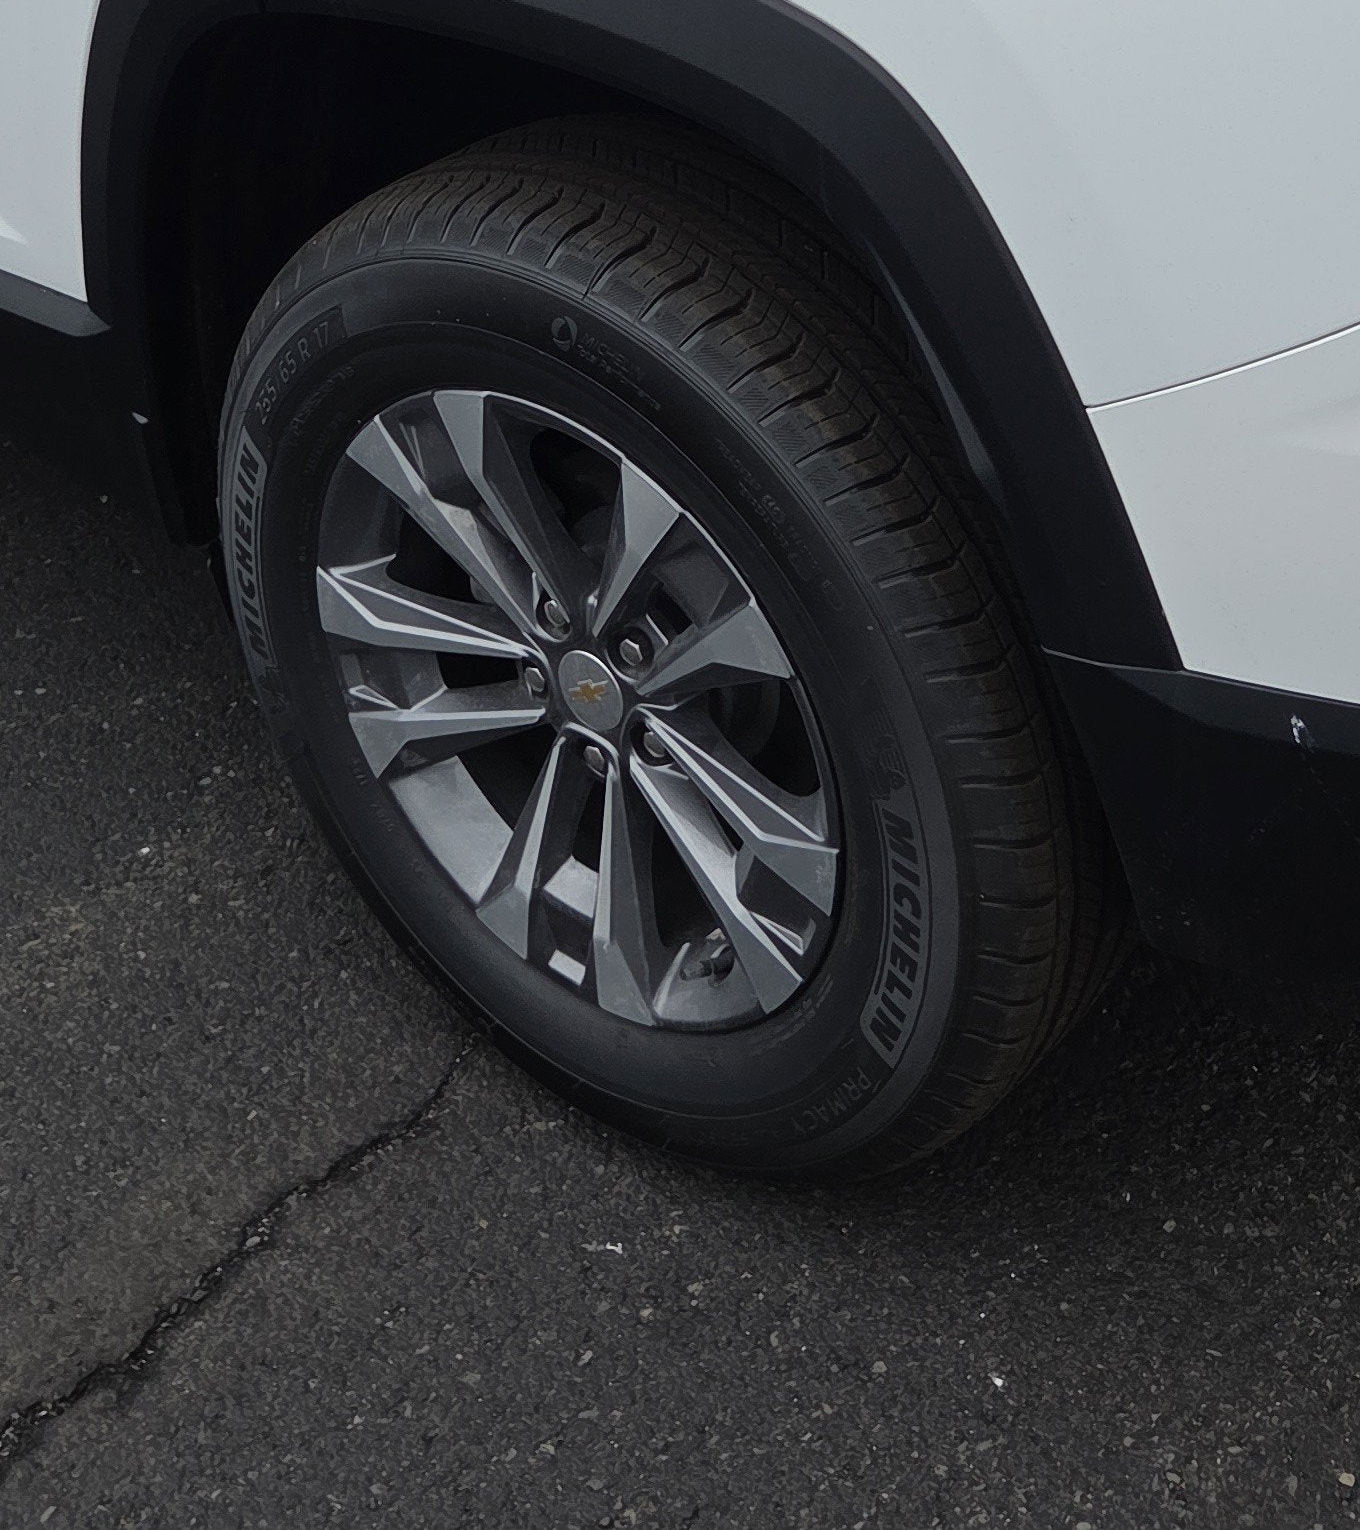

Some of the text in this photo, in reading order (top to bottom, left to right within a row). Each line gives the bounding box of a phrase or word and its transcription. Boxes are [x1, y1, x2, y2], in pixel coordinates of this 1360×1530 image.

[234, 443, 269, 659] MICHELIN
[868, 808, 923, 1053] MICHELIN
[789, 1066, 872, 1134] PRIMACY
